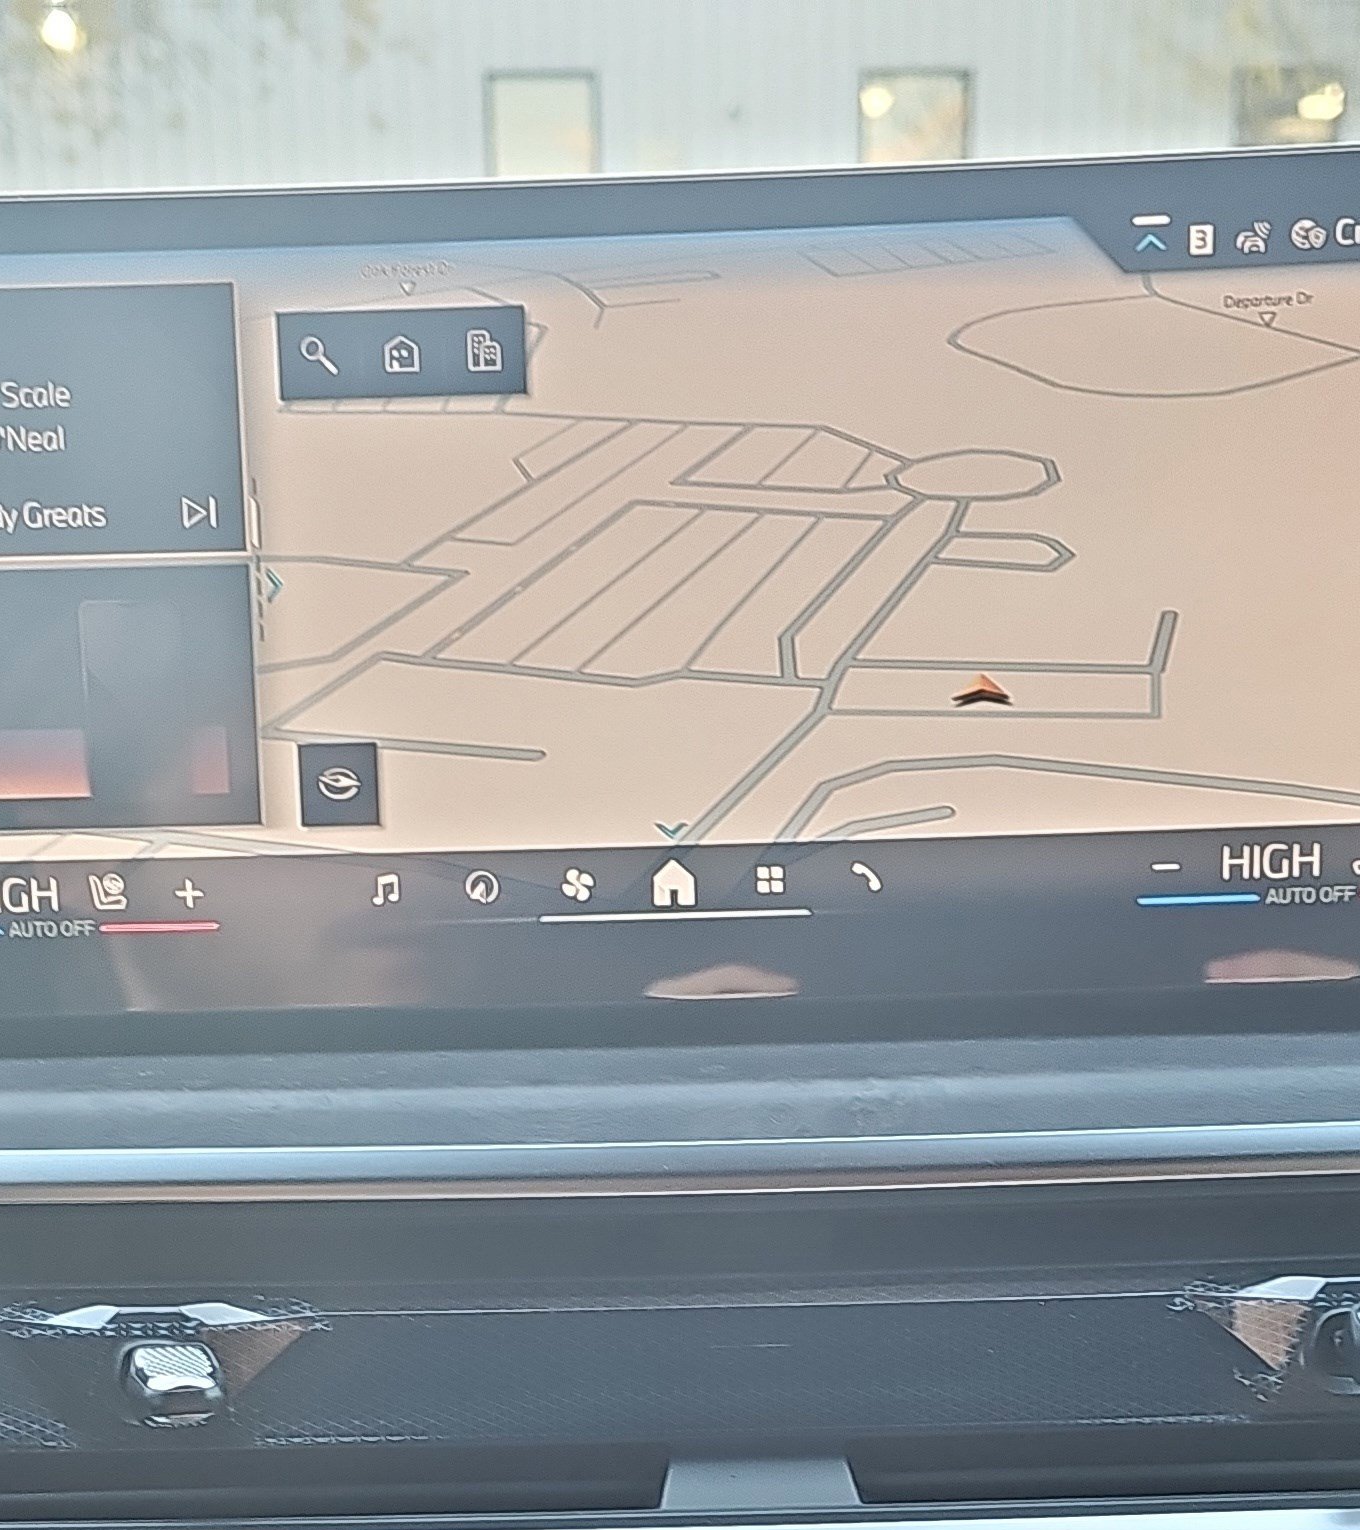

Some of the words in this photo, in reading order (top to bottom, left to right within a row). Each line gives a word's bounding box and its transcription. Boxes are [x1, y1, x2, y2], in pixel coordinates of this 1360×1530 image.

[0, 380, 71, 409] Scale
[22, 501, 108, 529] Greats
[1220, 843, 1321, 880] HIGH
[1265, 887, 1316, 905] AUTO
[1319, 885, 1357, 903] OFF
[8, 921, 58, 938] AUTO
[60, 920, 96, 937] OFF
